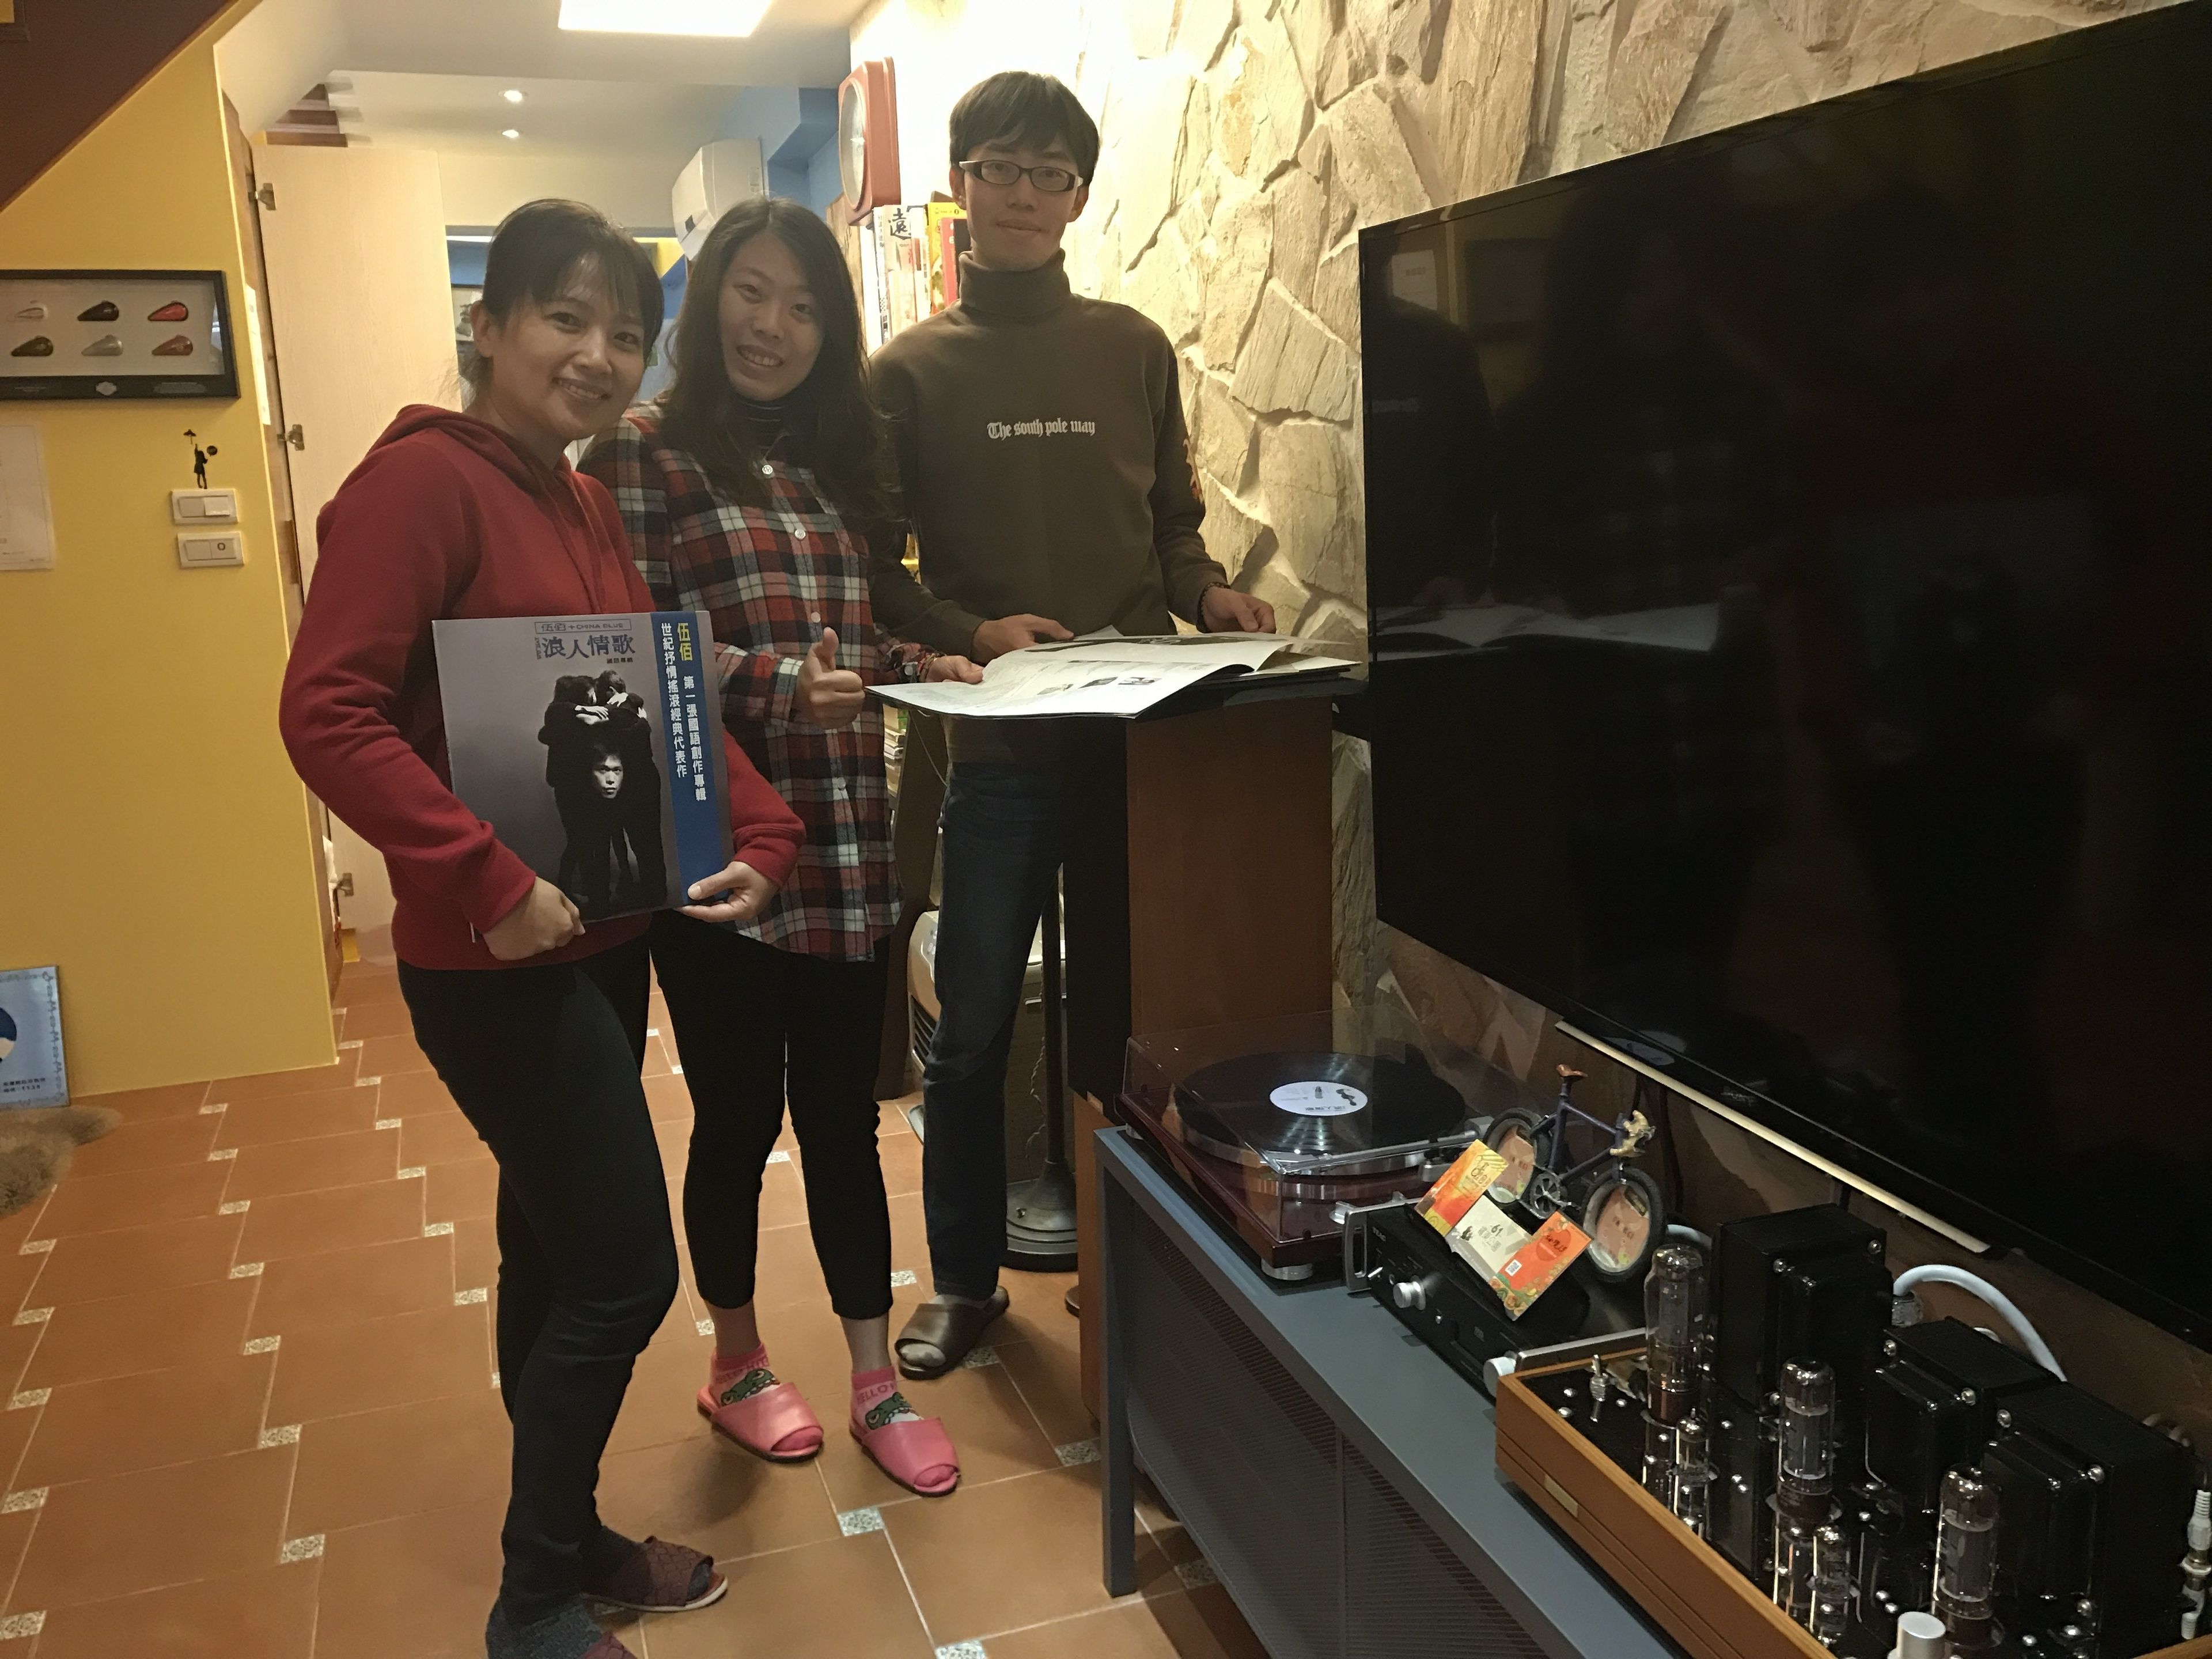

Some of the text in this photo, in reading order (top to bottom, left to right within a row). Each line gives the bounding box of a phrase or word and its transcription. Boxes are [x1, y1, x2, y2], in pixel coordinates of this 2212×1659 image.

[888, 207, 912, 240] 遠
[987, 417, 1095, 441] The south pole way
[541, 634, 636, 660] 浪人情歌
[677, 623, 693, 661] 伍佰
[661, 622, 688, 778] 世紀抒情搖滾經典代表作
